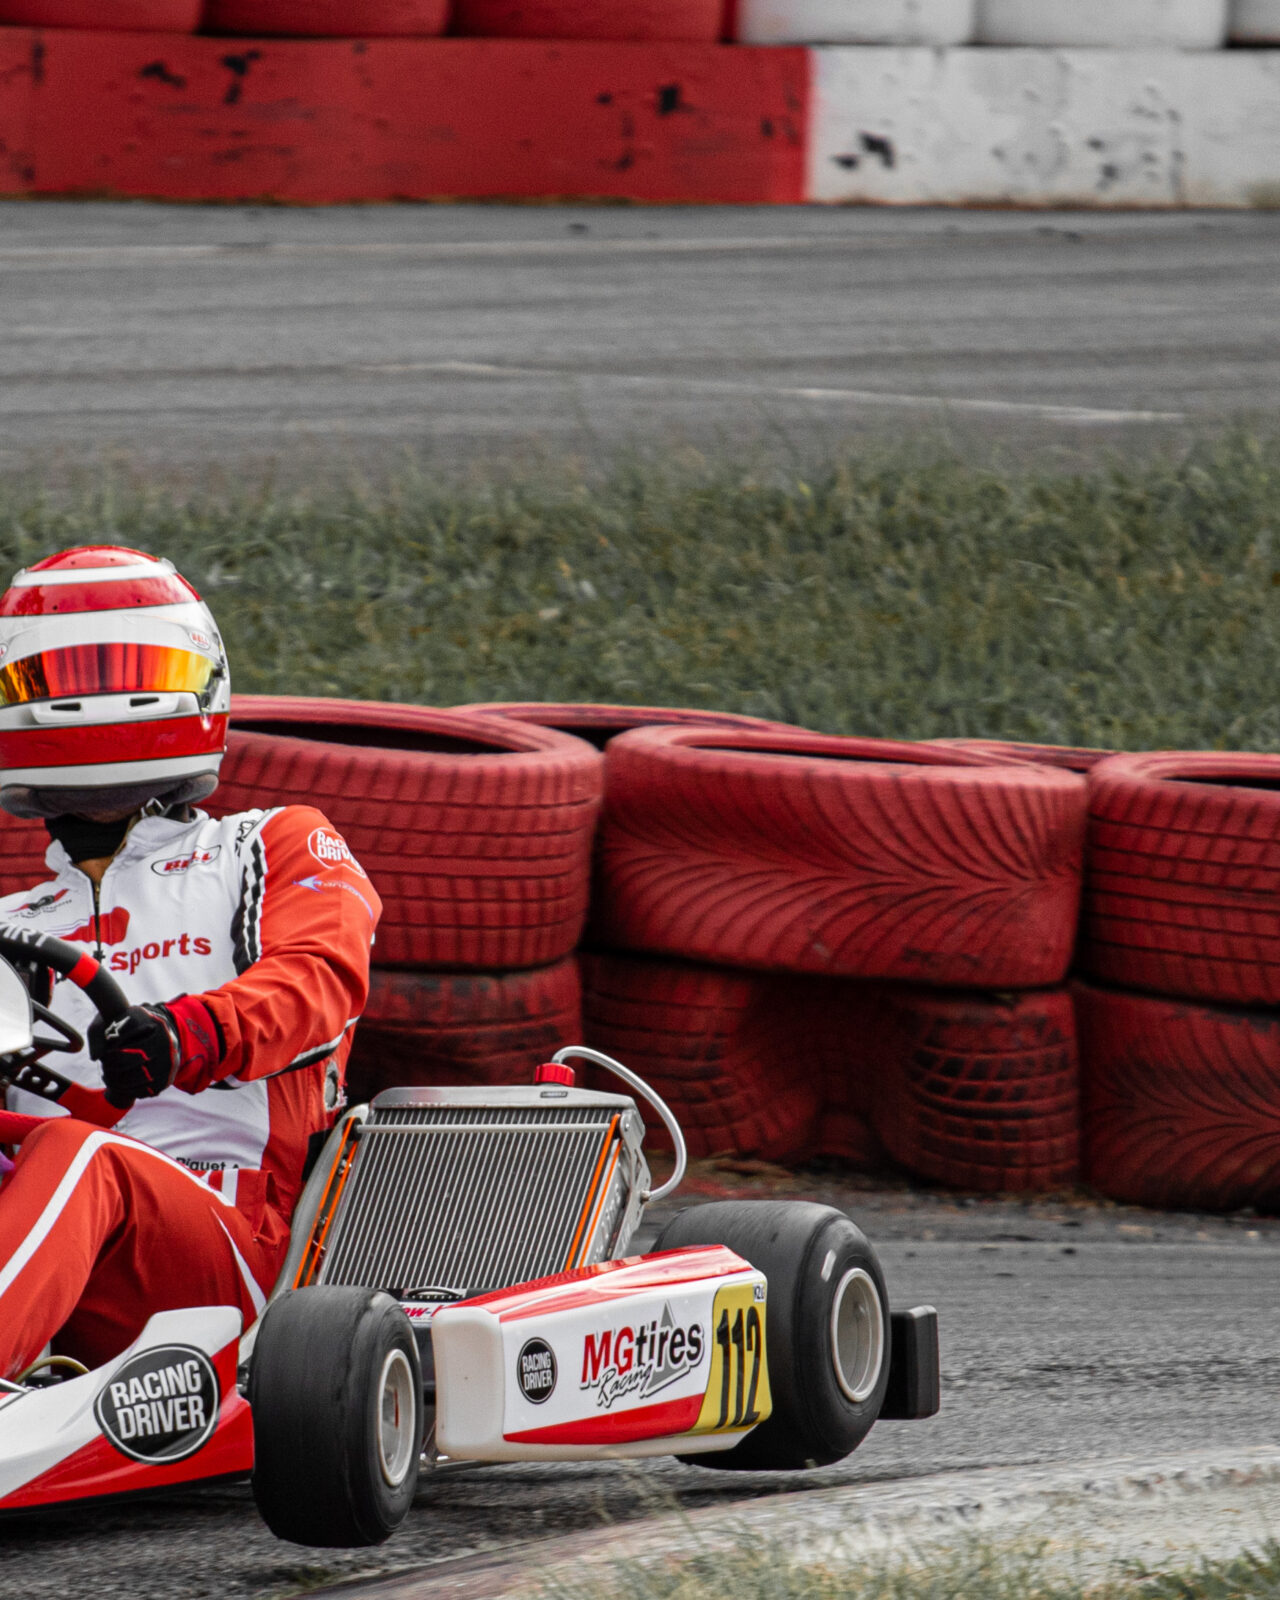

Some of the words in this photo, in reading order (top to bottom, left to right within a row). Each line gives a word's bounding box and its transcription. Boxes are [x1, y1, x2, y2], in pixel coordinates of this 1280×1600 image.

[316, 830, 348, 849] RAC
[316, 845, 363, 874] DRIV
[522, 1351, 552, 1373] RACING
[714, 1305, 762, 1430] 112
[109, 1359, 202, 1408] RACING
[523, 1369, 553, 1390] DRIVER
[597, 1363, 653, 1402] Racing
[116, 1395, 207, 1440] DRIVER
